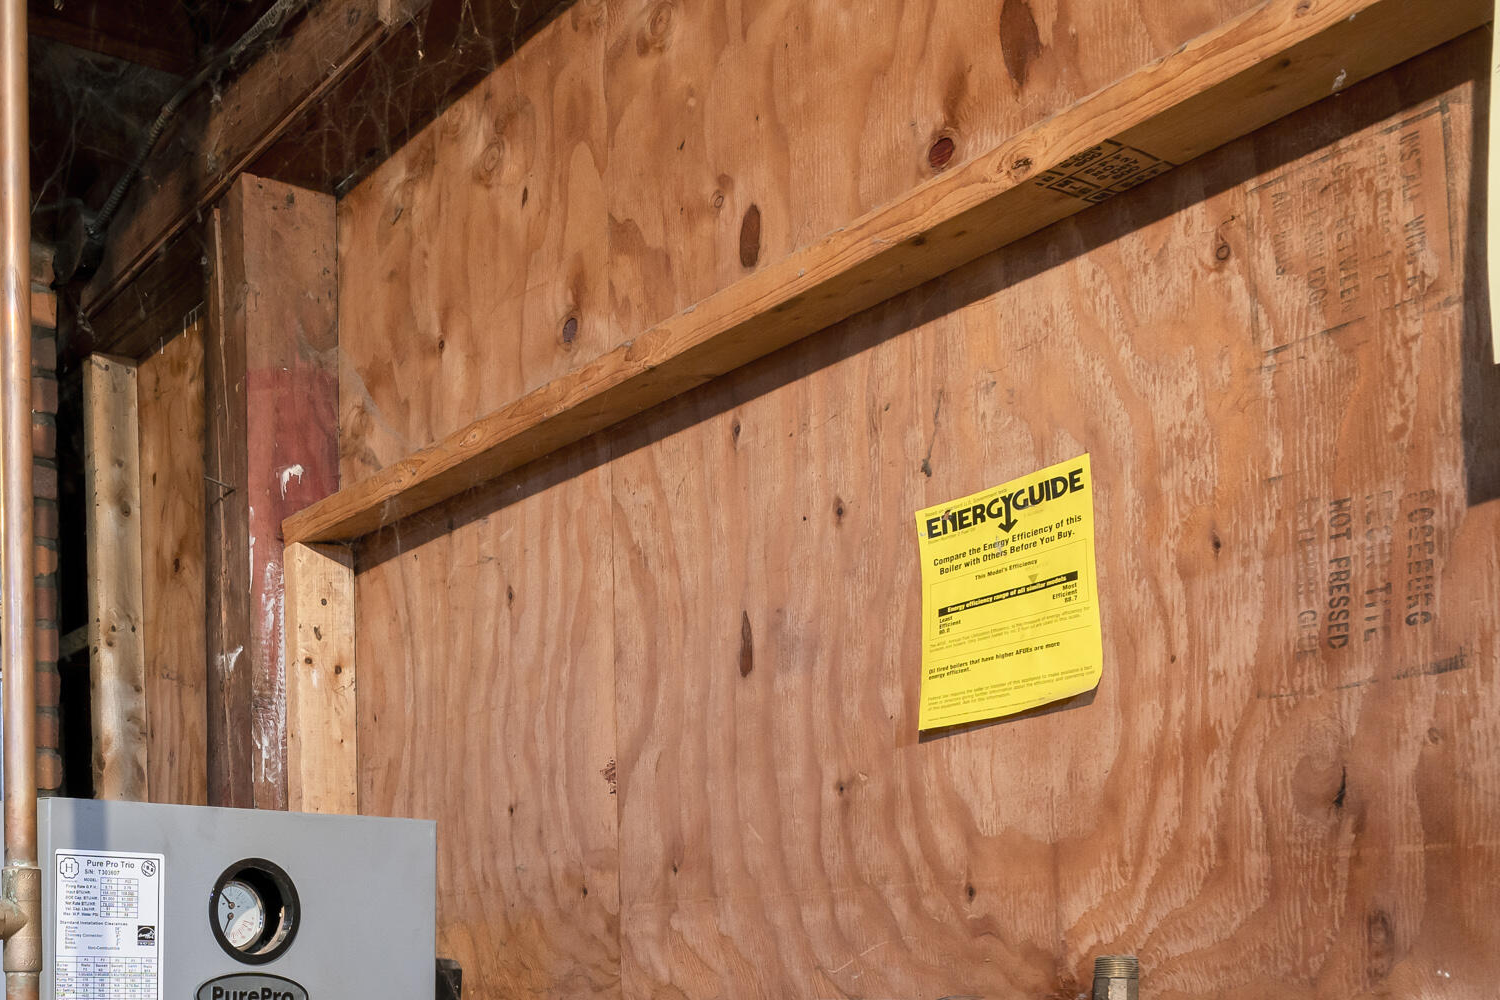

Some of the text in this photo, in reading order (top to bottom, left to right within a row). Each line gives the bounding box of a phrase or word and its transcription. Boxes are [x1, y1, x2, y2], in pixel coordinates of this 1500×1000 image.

[926, 468, 1084, 539] ENERGYGUIDE
[933, 515, 1082, 566] Compare the Energy Efficiency of this
[939, 529, 1076, 575] Boiler with Others Before You Buy.
[975, 573, 986, 581] This
[1008, 559, 1038, 571] Efficiency
[1062, 582, 1078, 591] Most
[1327, 556, 1351, 650] PRESSED
[950, 661, 968, 671] boilers
[969, 657, 980, 666] that
[981, 655, 994, 663] have
[995, 650, 1014, 660] higher
[1045, 641, 1060, 649] more
[928, 672, 945, 681] energy
[105, 860, 119, 868] Pro
[120, 861, 135, 869] Trio
